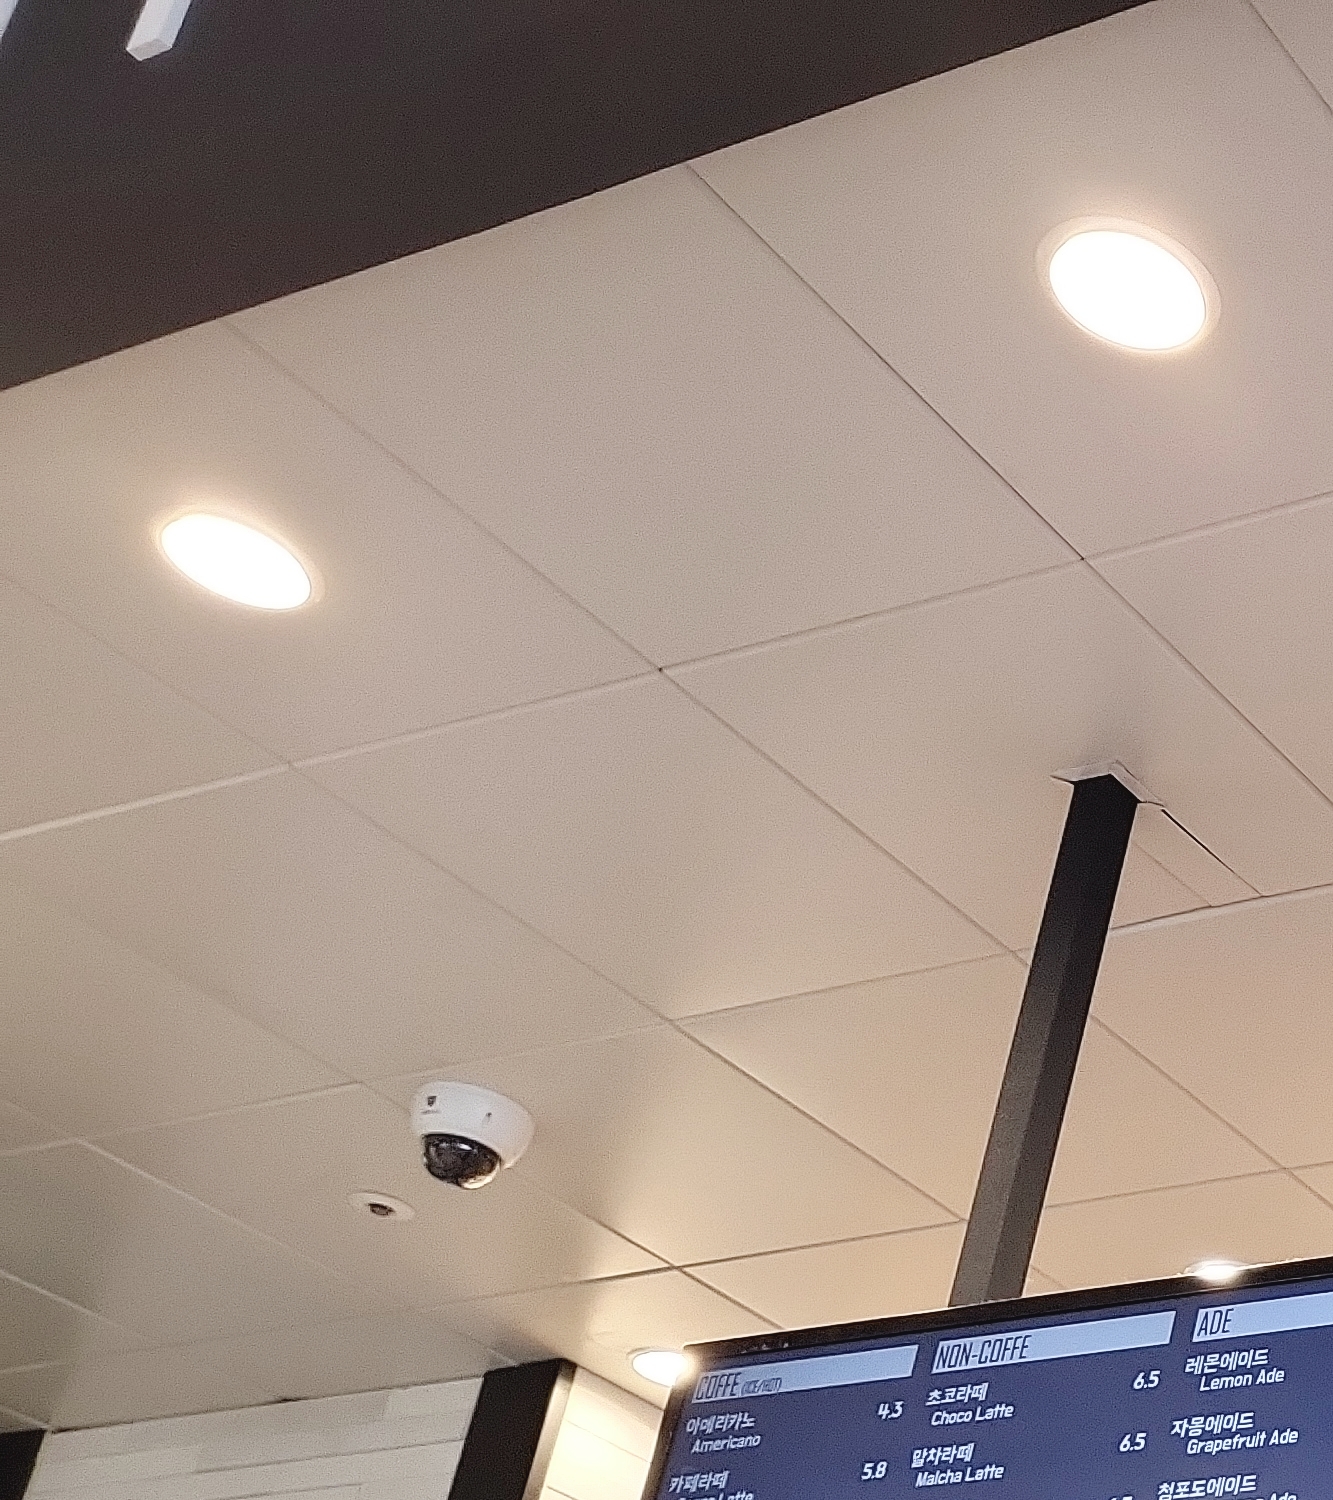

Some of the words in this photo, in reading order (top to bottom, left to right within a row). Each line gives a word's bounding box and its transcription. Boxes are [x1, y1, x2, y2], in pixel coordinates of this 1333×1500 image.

[1197, 1308, 1234, 1336] ADE
[937, 1335, 1031, 1368] NON-COFFE
[1185, 1349, 1268, 1374] 레몬에이드
[1134, 1371, 1160, 1389] 6.5
[1200, 1375, 1252, 1391] Lemon
[1256, 1368, 1284, 1384] Ade
[926, 1383, 988, 1405] 초코라떼
[878, 1402, 903, 1419] 4.3
[932, 1411, 972, 1425] Choco
[975, 1404, 1013, 1420] Latte
[1171, 1413, 1253, 1437] 자몽에이드
[691, 1436, 761, 1452] Americano
[1187, 1429, 1266, 1455] Grapefruit
[1269, 1429, 1298, 1445] Ade
